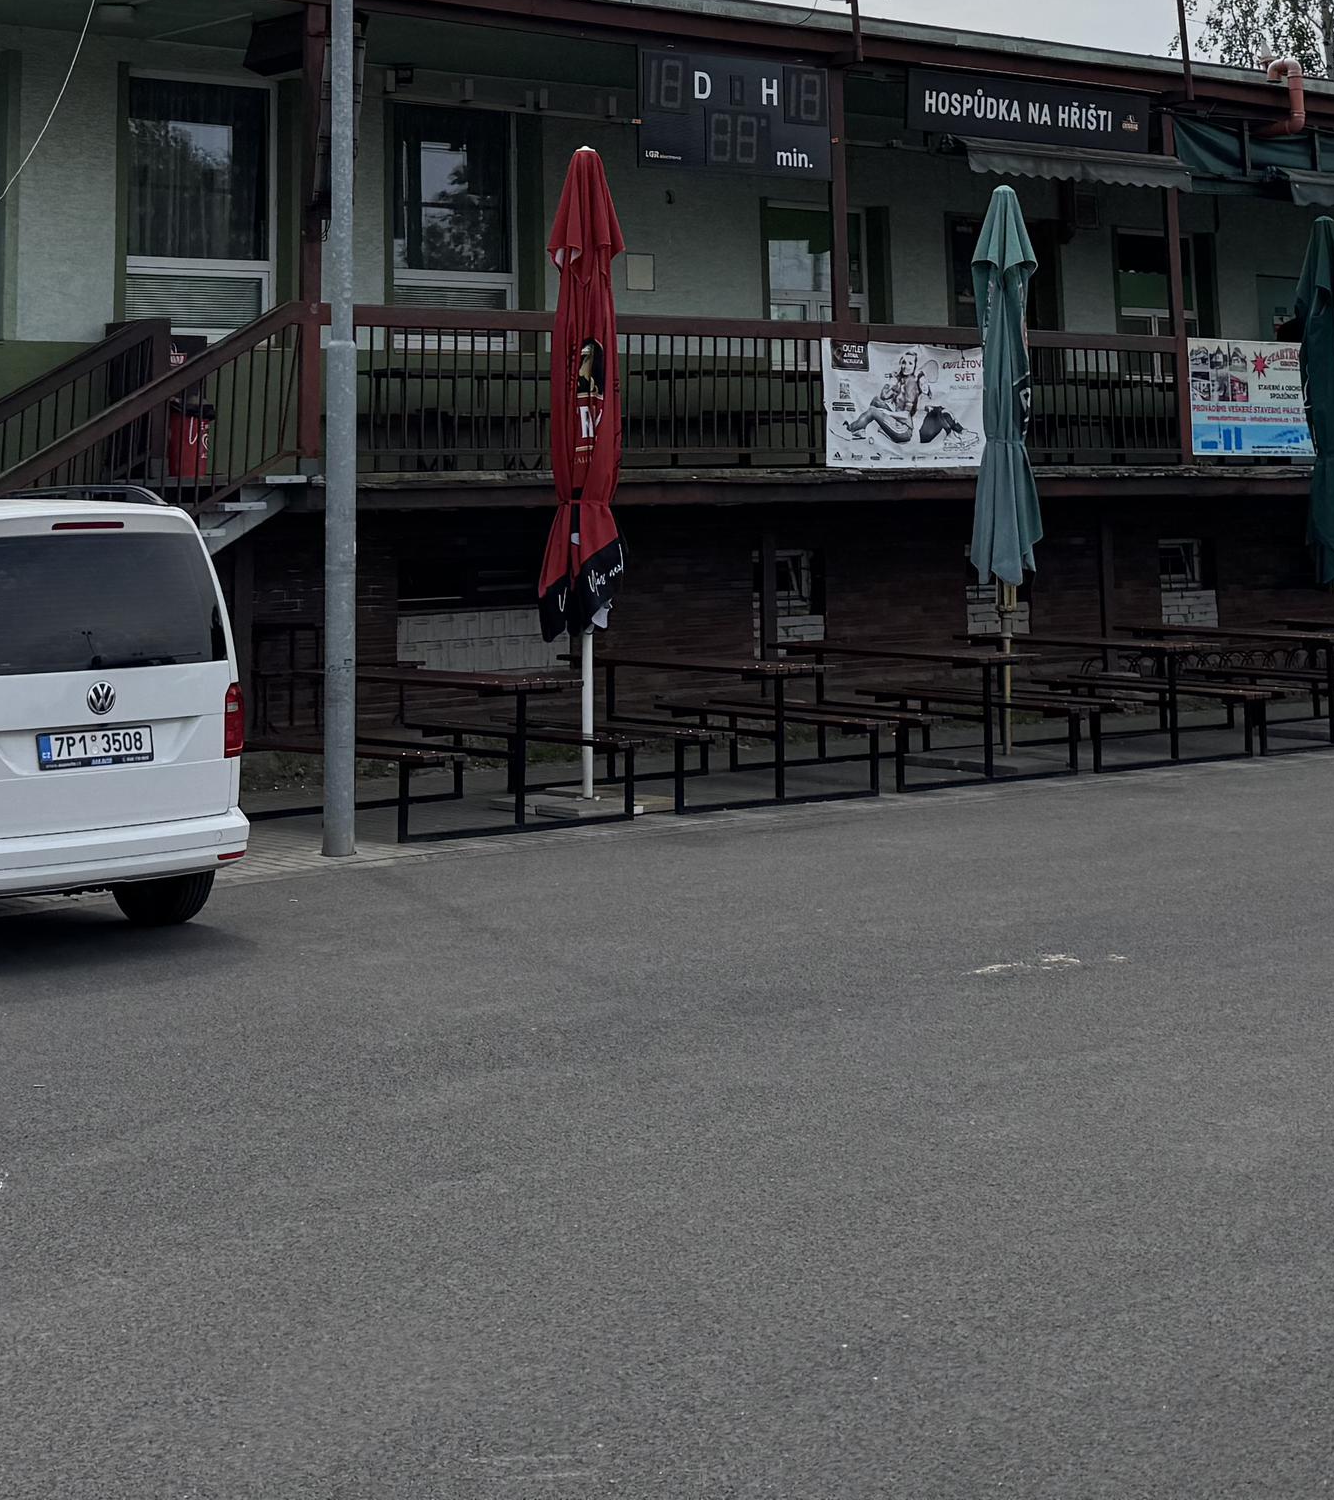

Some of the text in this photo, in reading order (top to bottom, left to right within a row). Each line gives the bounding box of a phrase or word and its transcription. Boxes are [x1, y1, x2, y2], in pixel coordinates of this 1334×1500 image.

[693, 70, 778, 106] D H
[924, 88, 1113, 132] HOSPŮDKA NA HŘIŠTI
[776, 148, 814, 168] min.
[842, 344, 865, 354] OUTLET
[54, 731, 143, 758] 7P1 3508
